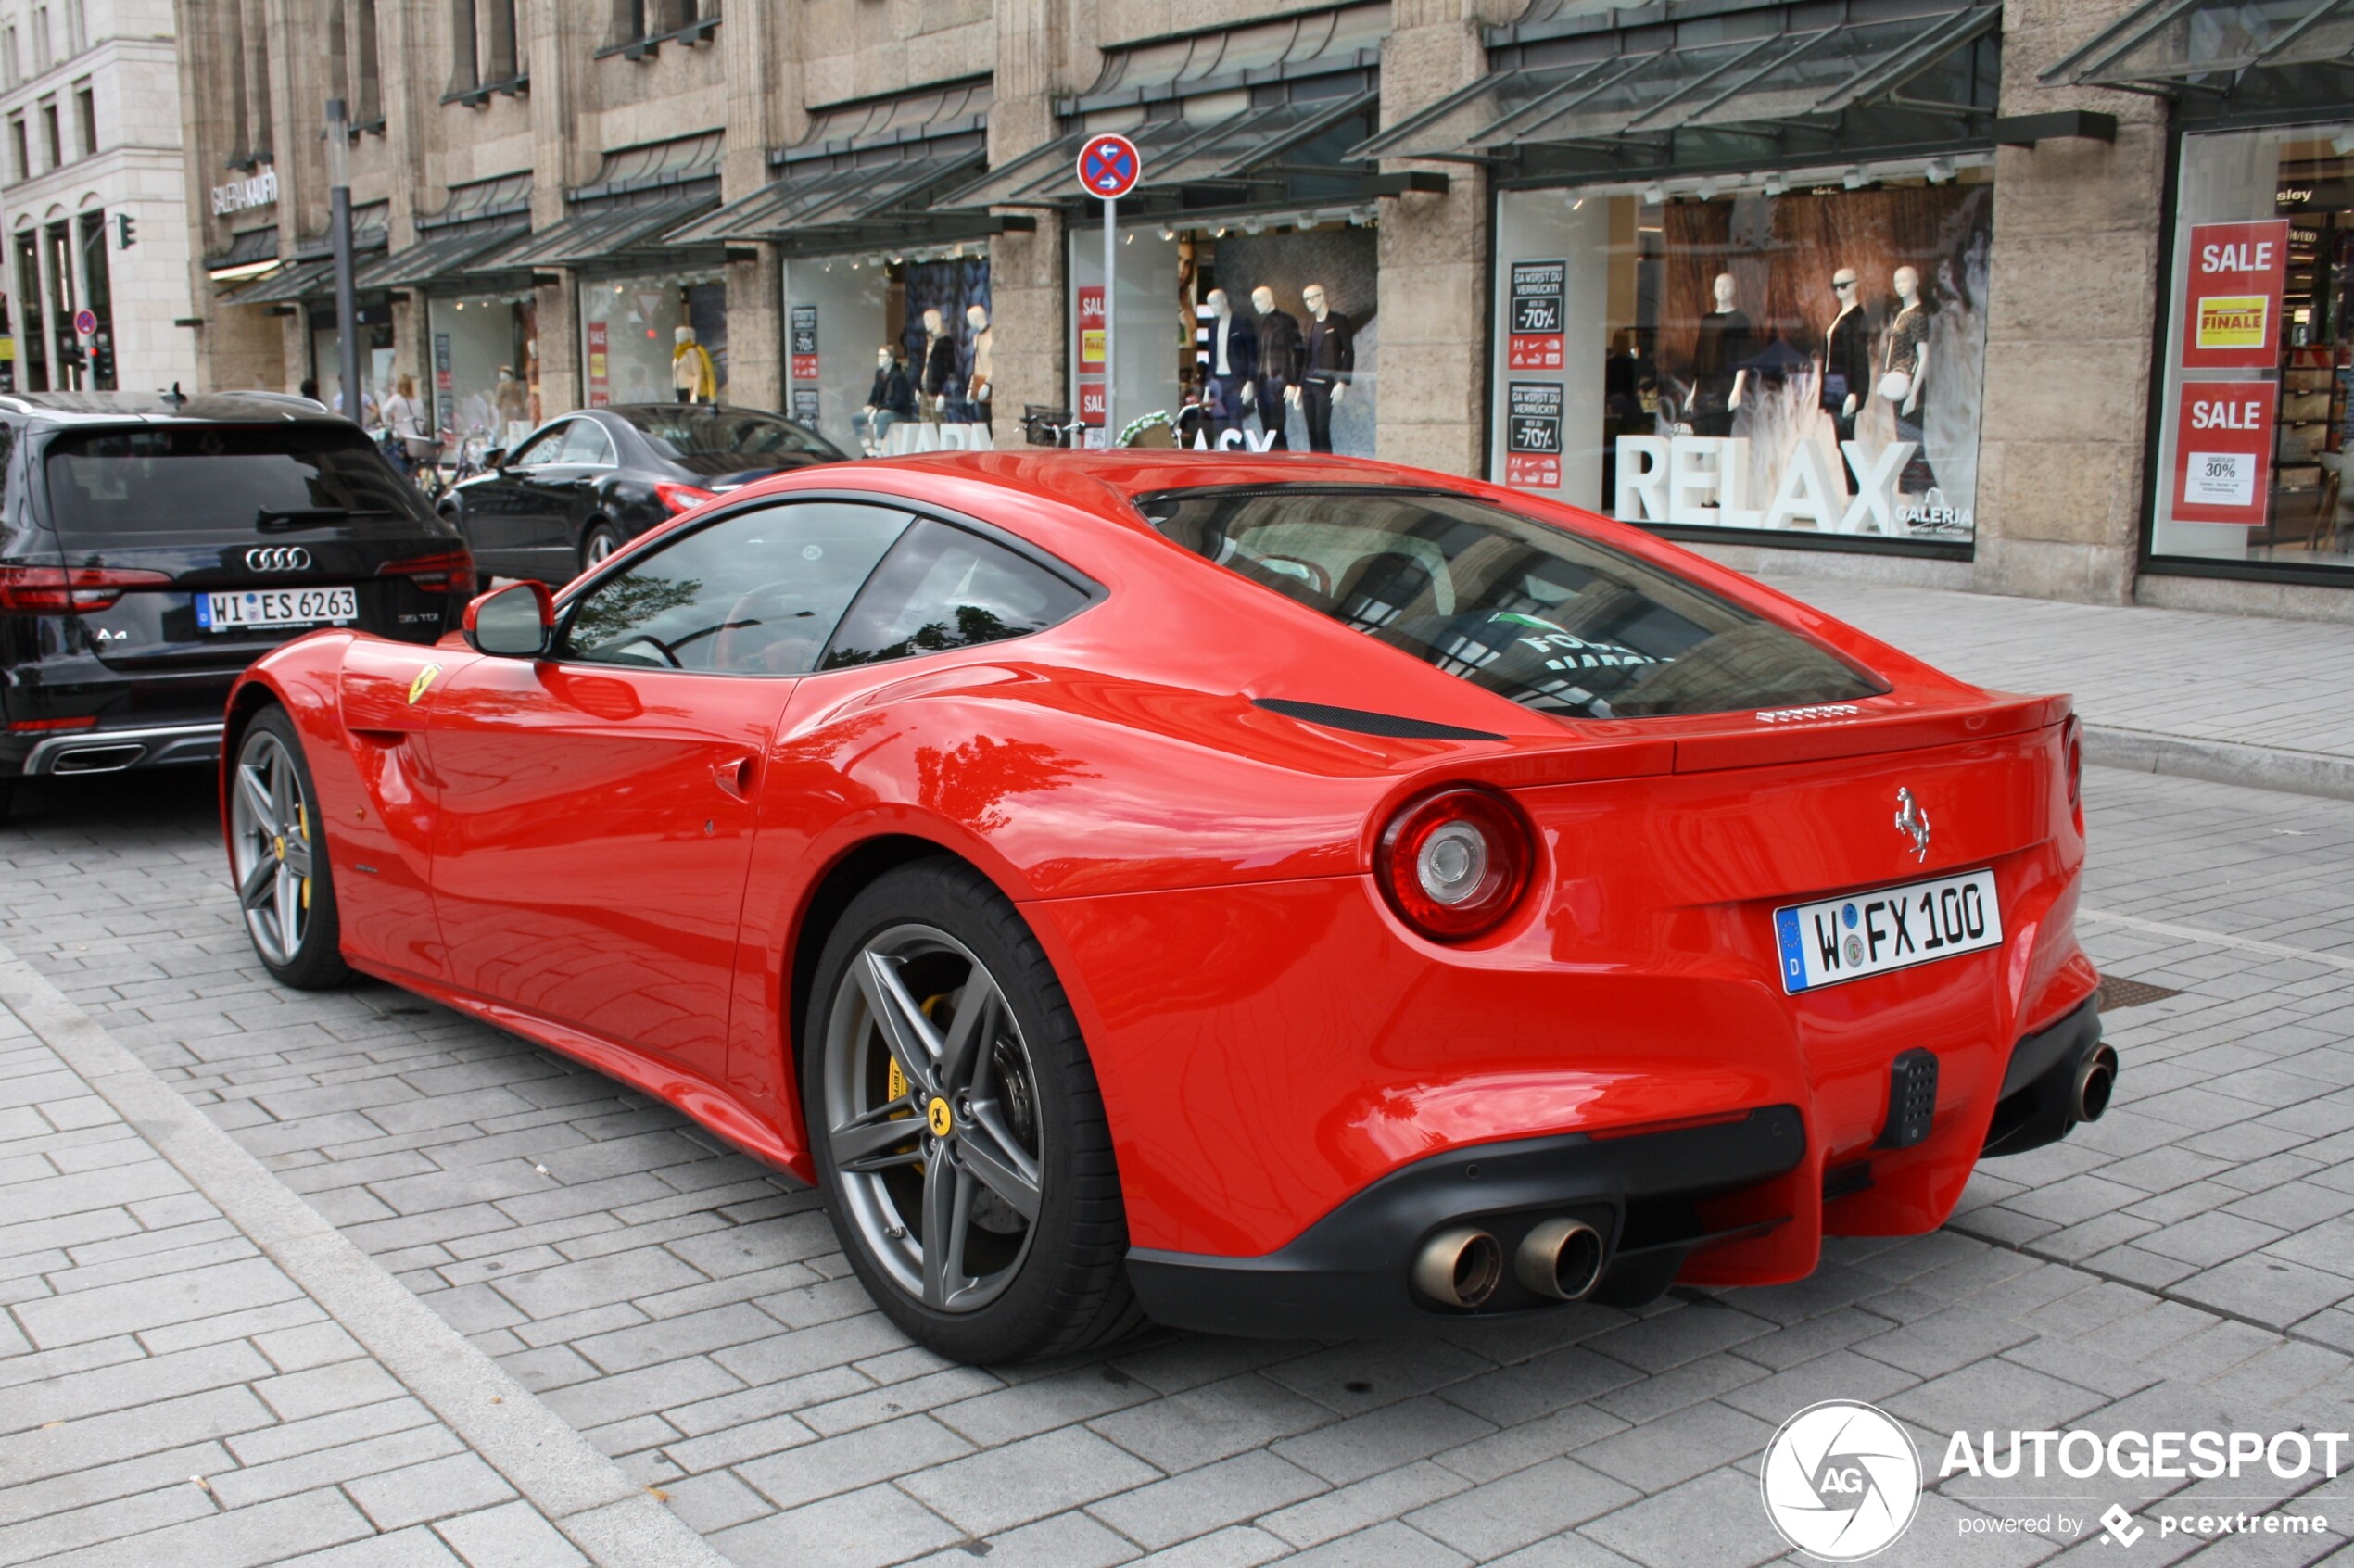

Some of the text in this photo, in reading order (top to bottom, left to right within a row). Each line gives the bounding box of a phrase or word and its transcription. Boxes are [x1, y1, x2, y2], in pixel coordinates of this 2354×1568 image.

[2276, 188, 2312, 202] sley
[2201, 242, 2272, 273] SALE
[1550, 272, 1563, 282] DU
[1082, 297, 1105, 315] SAL
[1519, 308, 1555, 328] -70%
[2202, 316, 2261, 330] FINALE
[1084, 395, 1105, 413] SAL
[1549, 393, 1561, 402] DU
[2191, 400, 2261, 429] SALE
[1516, 427, 1552, 448] -70%
[2205, 462, 2235, 478] 30%
[1615, 435, 1919, 537] RELAX
[1895, 504, 1972, 525] GALERIA
[212, 596, 243, 623] WI
[262, 593, 293, 620] ES
[299, 590, 355, 617] 6263
[97, 628, 128, 639] A4
[1790, 958, 1800, 976] D
[1814, 910, 1841, 972] W
